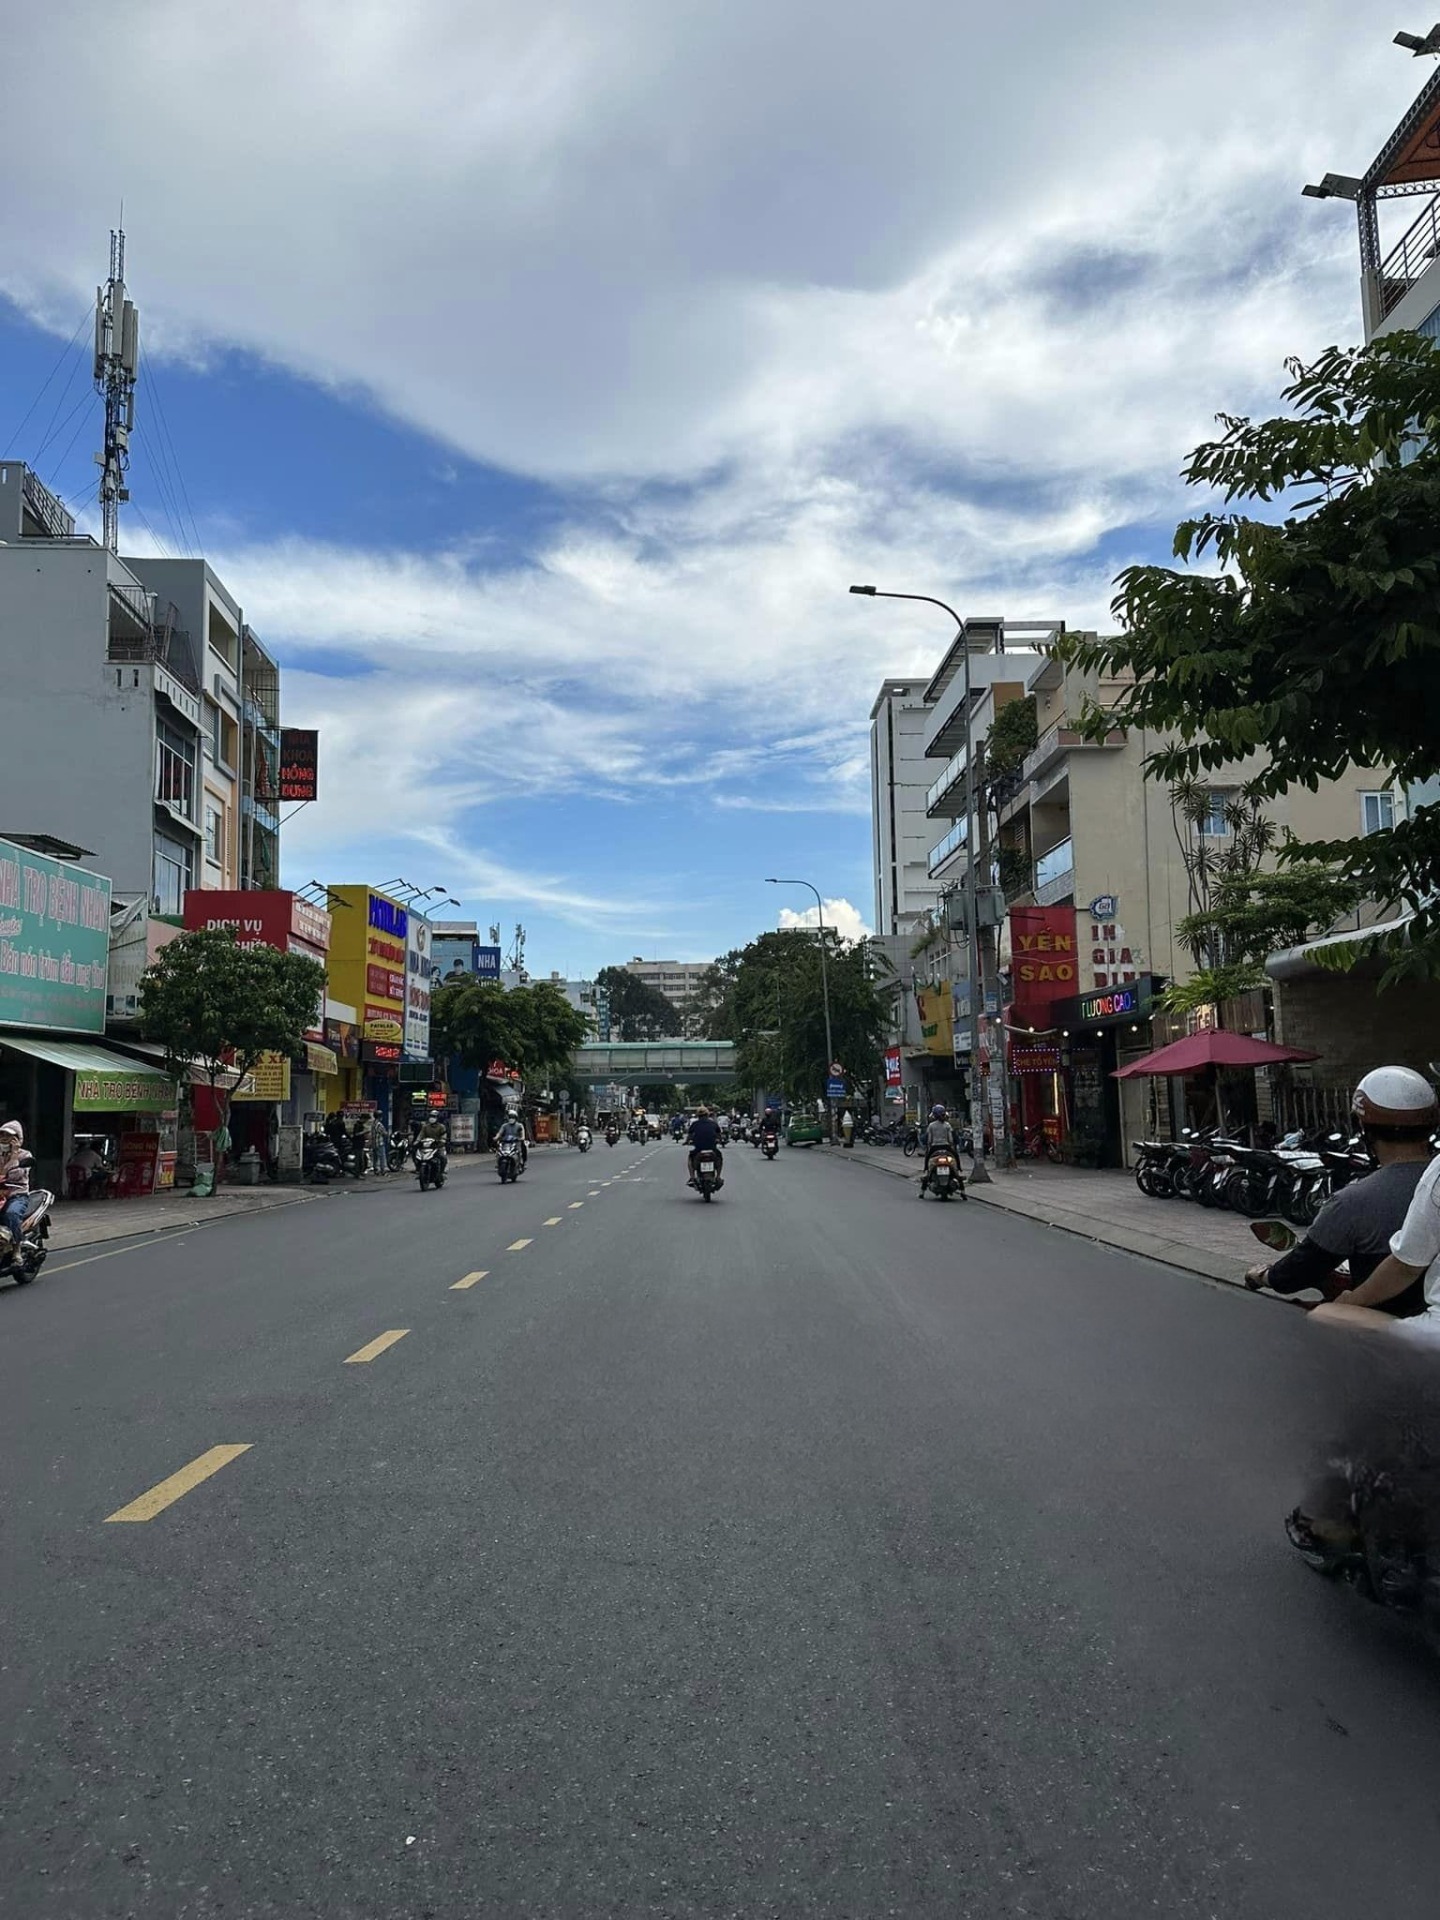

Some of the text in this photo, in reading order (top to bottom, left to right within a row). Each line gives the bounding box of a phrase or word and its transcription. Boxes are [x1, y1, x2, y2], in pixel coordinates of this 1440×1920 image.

[23, 865, 48, 927] TRỌ
[49, 865, 78, 932] BỆNH
[80, 878, 108, 933] NHÂN
[244, 919, 263, 935] VỤ
[1091, 924, 1116, 941] IN
[1018, 926, 1071, 951] YẾN
[478, 954, 496, 969] NHA
[1092, 947, 1134, 965] GIA
[1020, 964, 1074, 981] SAO
[1114, 992, 1131, 1012] CAO
[79, 1075, 101, 1100] NHÀ
[102, 1080, 122, 1104] TRỌ
